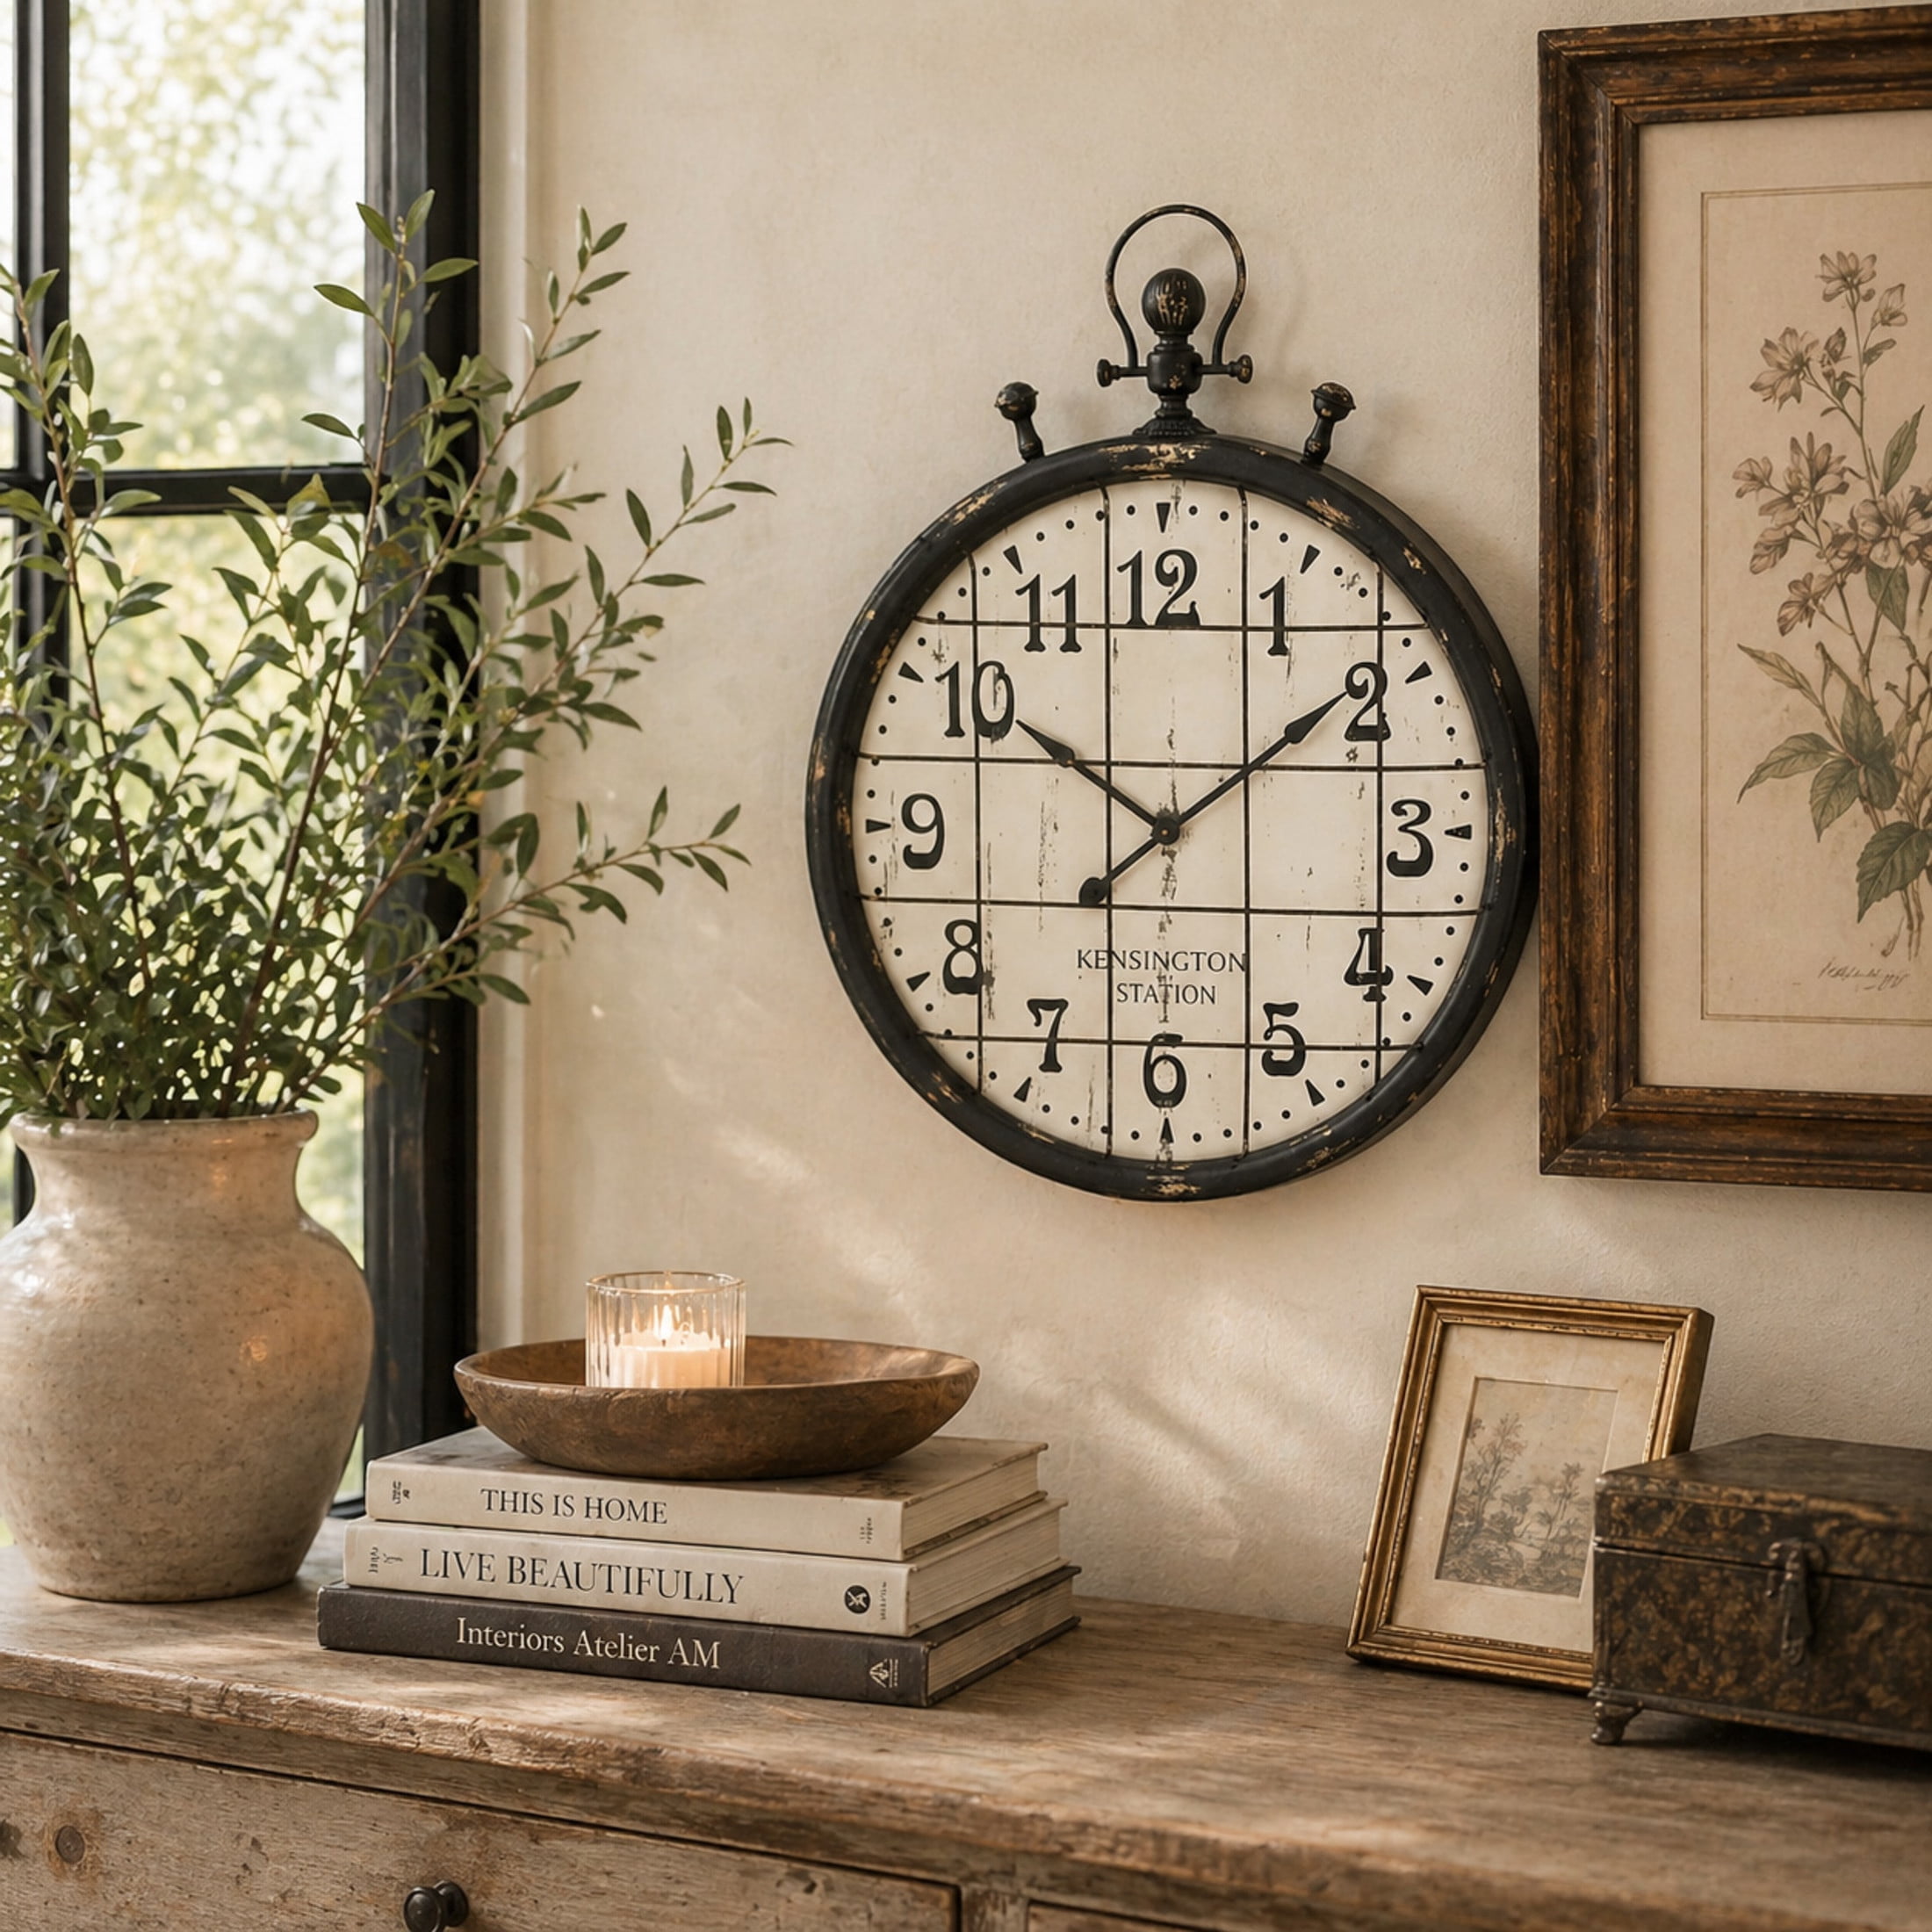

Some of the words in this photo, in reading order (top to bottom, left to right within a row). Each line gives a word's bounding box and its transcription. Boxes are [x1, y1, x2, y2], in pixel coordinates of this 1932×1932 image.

[1014, 573, 1083, 652] 11
[1116, 548, 1201, 627] 12
[1258, 575, 1289, 657] 1
[934, 660, 1015, 739] 10
[1344, 661, 1392, 742] 2
[900, 792, 946, 870] 9
[1386, 798, 1434, 878] 3
[941, 919, 984, 996] 8
[1077, 948, 1249, 973] KENSINGTON
[1115, 982, 1217, 1006] STATION
[1344, 927, 1395, 1002] 4
[1026, 998, 1070, 1073] 7
[1143, 1033, 1187, 1109] 6
[1260, 1001, 1307, 1077] 5
[480, 1488, 544, 1516] THIS
[551, 1494, 575, 1518] IS
[583, 1496, 668, 1525] HOME
[420, 1548, 496, 1582] LIVE
[507, 1555, 745, 1604] BEAUTIFULLY
[456, 1617, 566, 1654] Interiors
[573, 1630, 660, 1662] Atelier
[667, 1637, 721, 1669] AM
